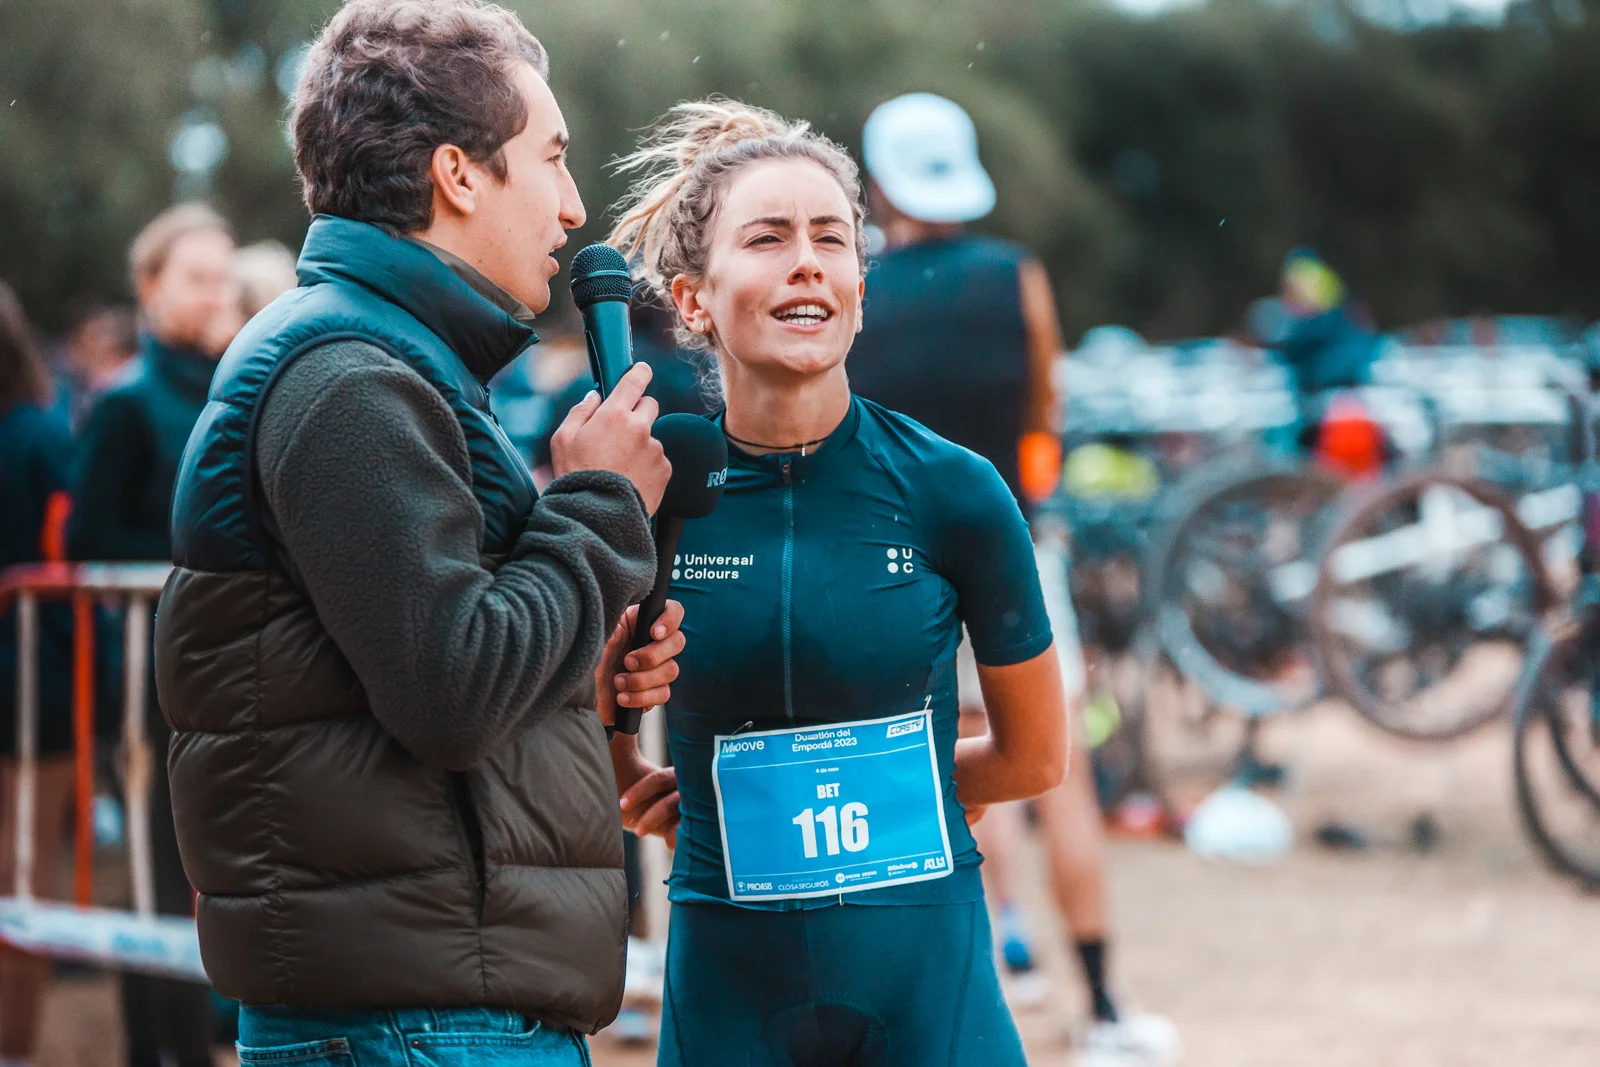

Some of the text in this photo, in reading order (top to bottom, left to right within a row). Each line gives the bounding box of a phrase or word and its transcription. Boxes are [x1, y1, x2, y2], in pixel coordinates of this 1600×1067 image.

[684, 553, 754, 566] Universal
[902, 547, 913, 560] U
[684, 567, 740, 580] Colours
[902, 561, 914, 574] C
[836, 728, 851, 737] del
[833, 737, 858, 748] 2023
[816, 782, 841, 799] BET
[792, 801, 870, 859] 116
